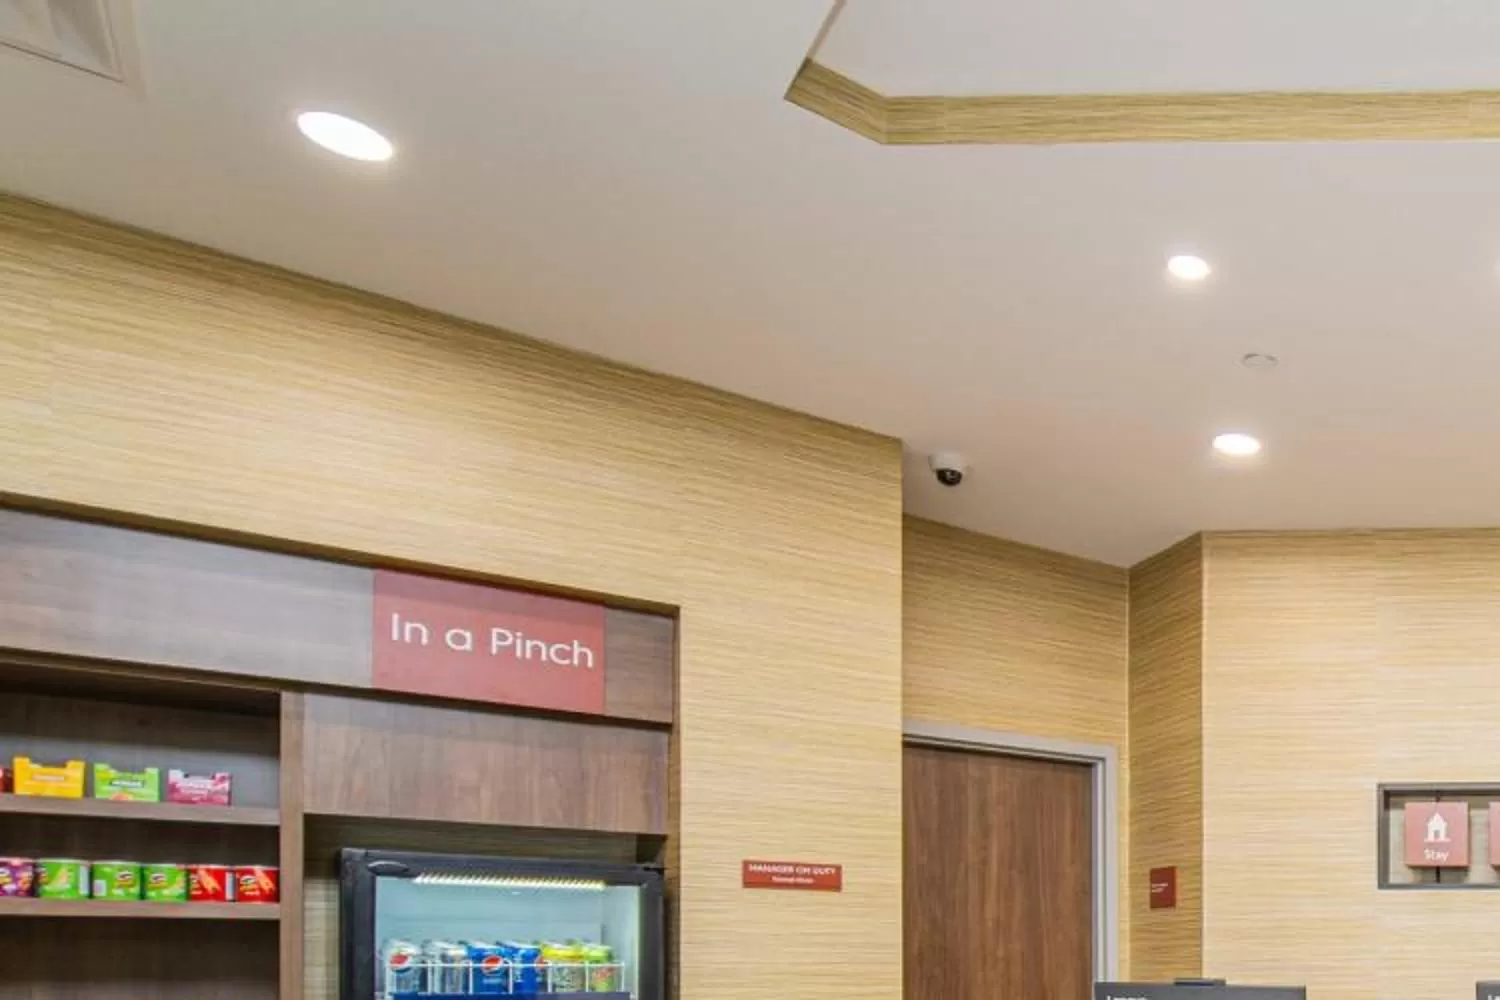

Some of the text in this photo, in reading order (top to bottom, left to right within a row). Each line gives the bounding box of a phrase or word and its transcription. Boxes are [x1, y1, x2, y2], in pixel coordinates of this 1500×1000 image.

[391, 611, 594, 668] In a Pinch
[1423, 849, 1449, 862] Stay
